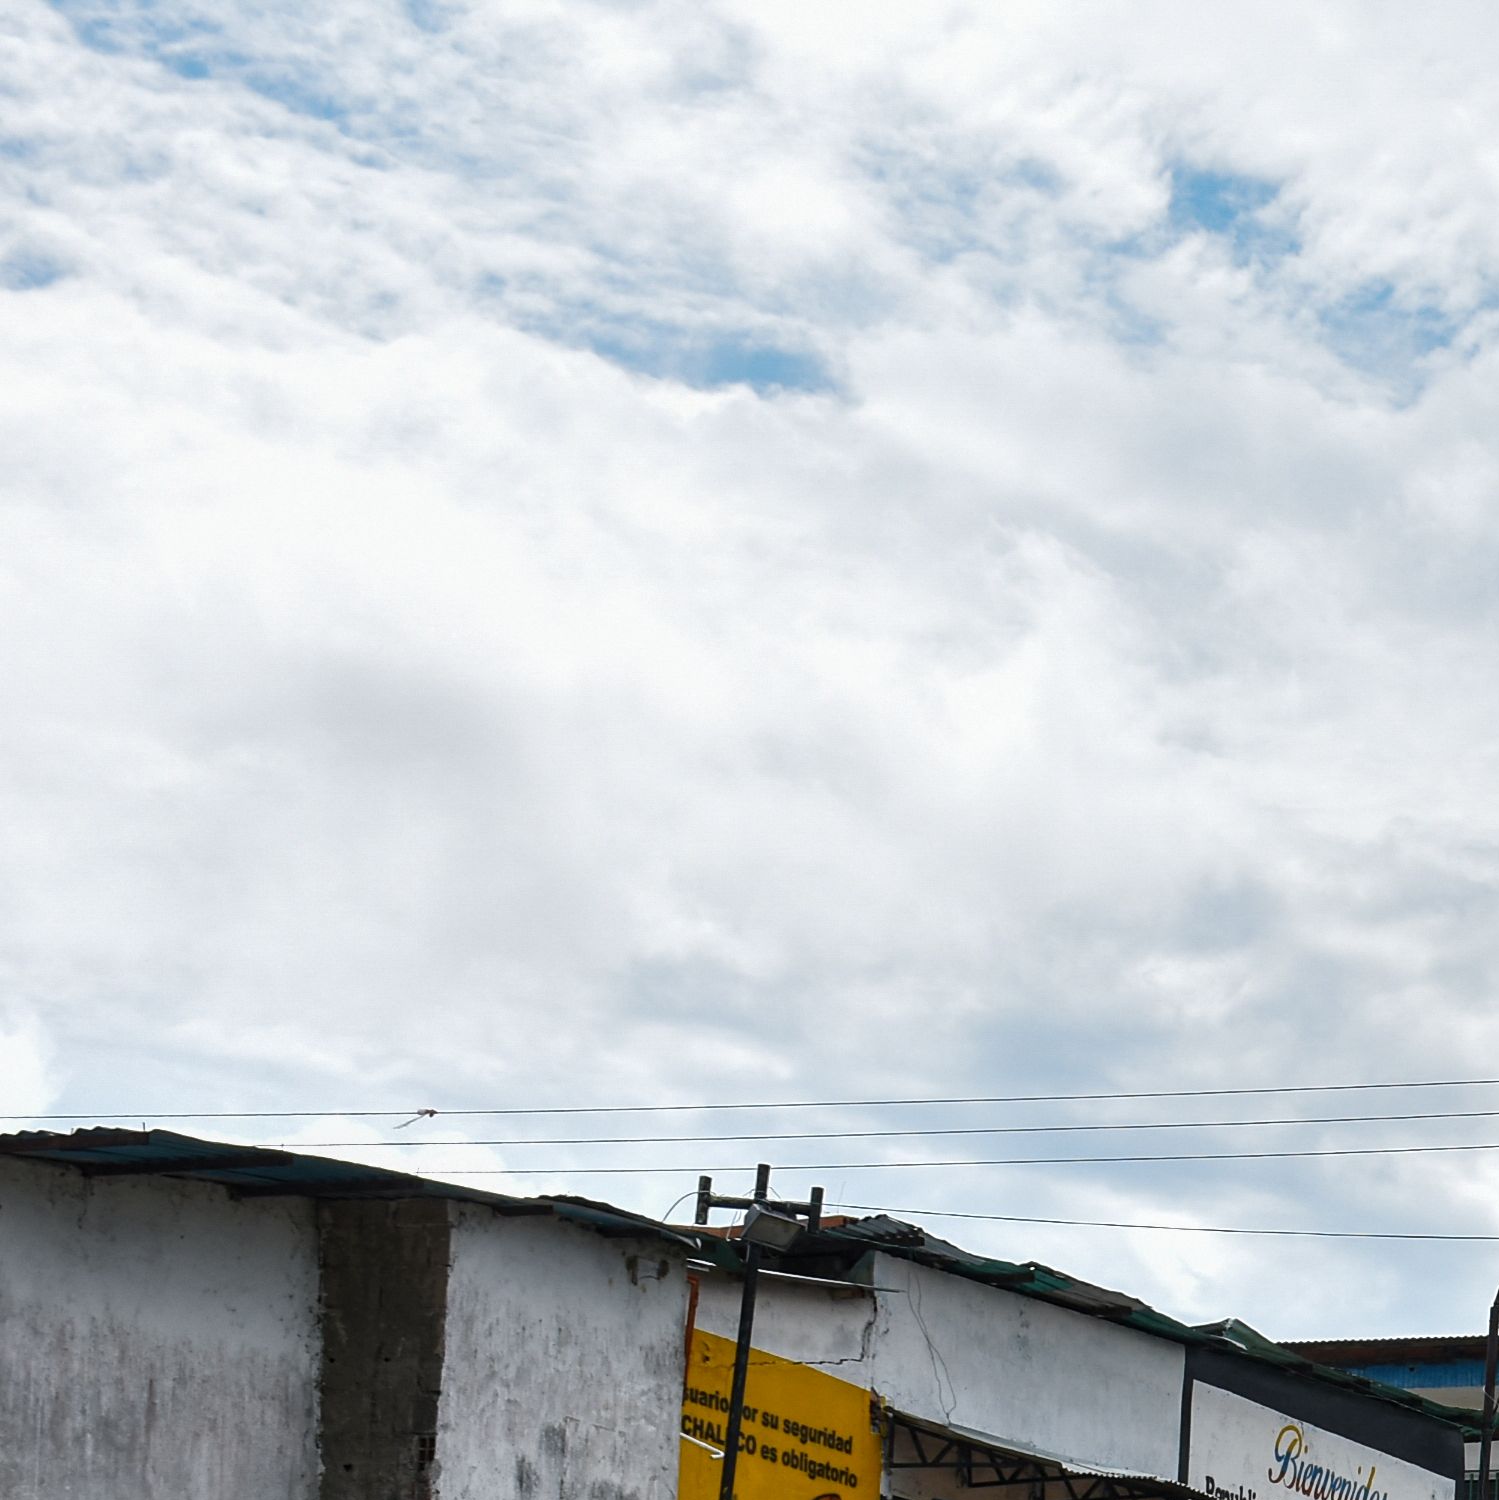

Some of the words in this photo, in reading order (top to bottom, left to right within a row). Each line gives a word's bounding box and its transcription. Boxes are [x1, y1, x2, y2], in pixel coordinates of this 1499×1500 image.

[681, 1414, 757, 1456] CHALCO
[760, 1444, 778, 1463] es
[782, 1451, 858, 1488] obligatorio
[742, 1405, 758, 1423] or
[761, 1410, 778, 1430] su
[783, 1418, 853, 1455] seguridad
